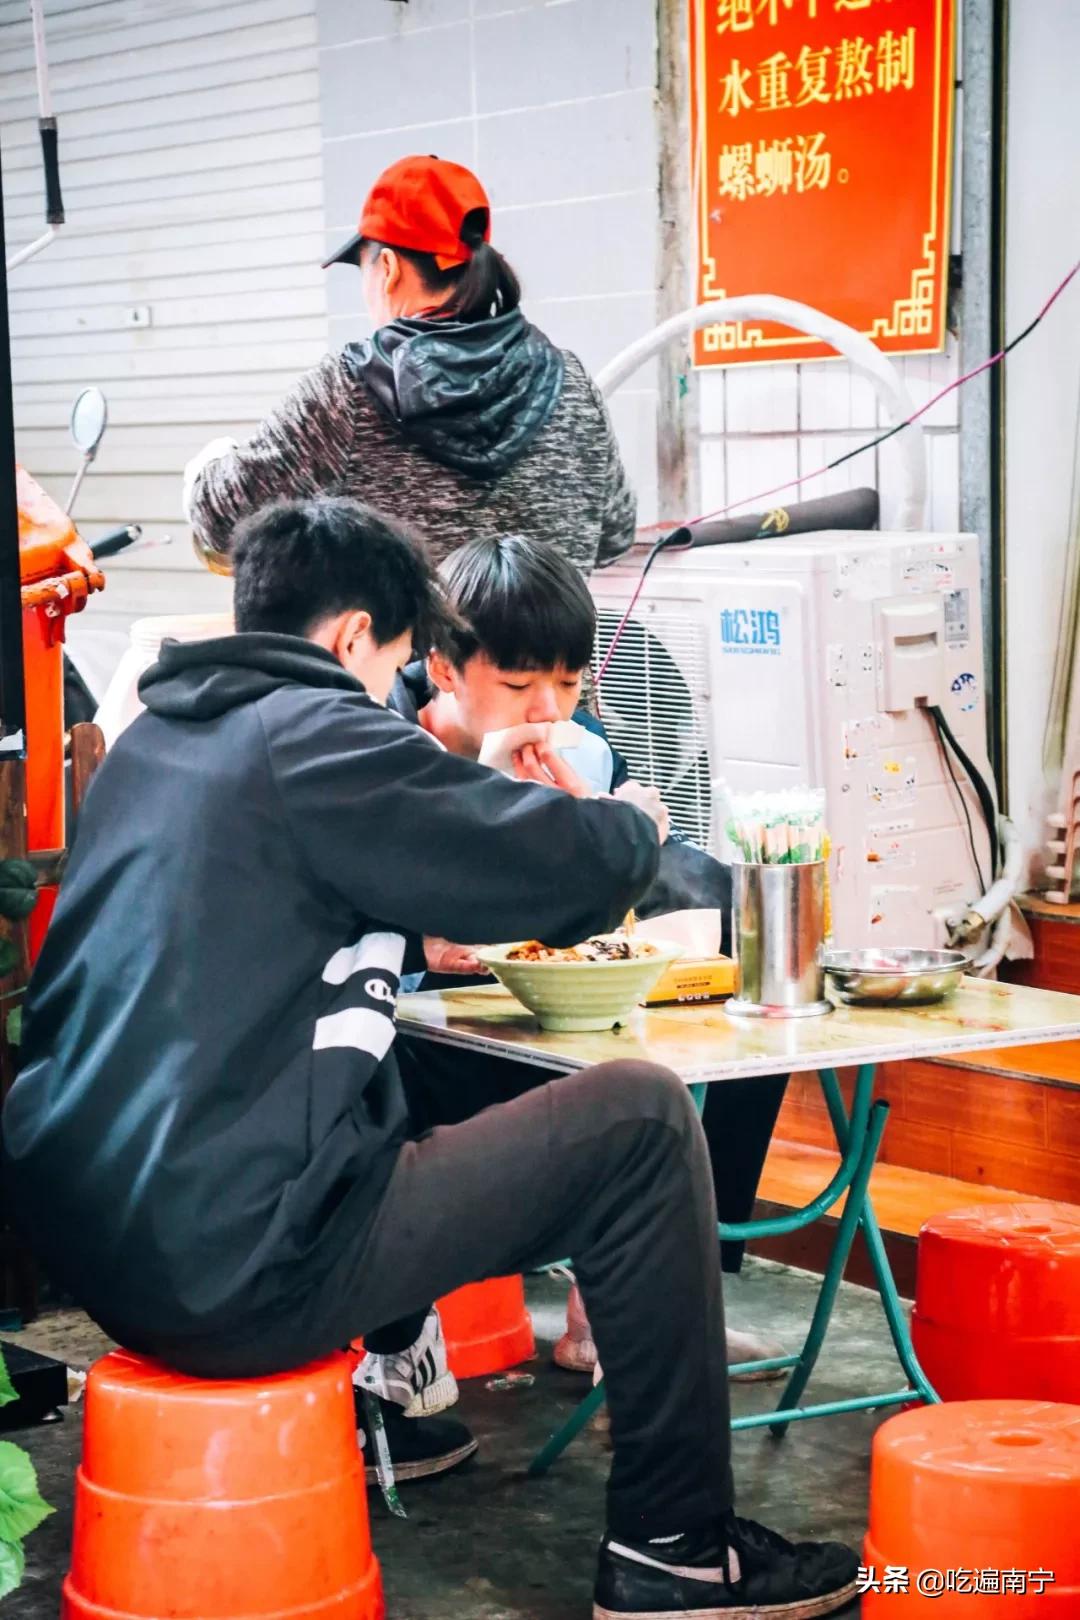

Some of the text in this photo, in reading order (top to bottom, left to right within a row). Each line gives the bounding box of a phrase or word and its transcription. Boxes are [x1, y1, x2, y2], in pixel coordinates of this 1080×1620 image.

[718, 27, 916, 117] 水重复熬制
[718, 132, 849, 201] 螺蛳汤。
[720, 609, 780, 645] 松鸿
